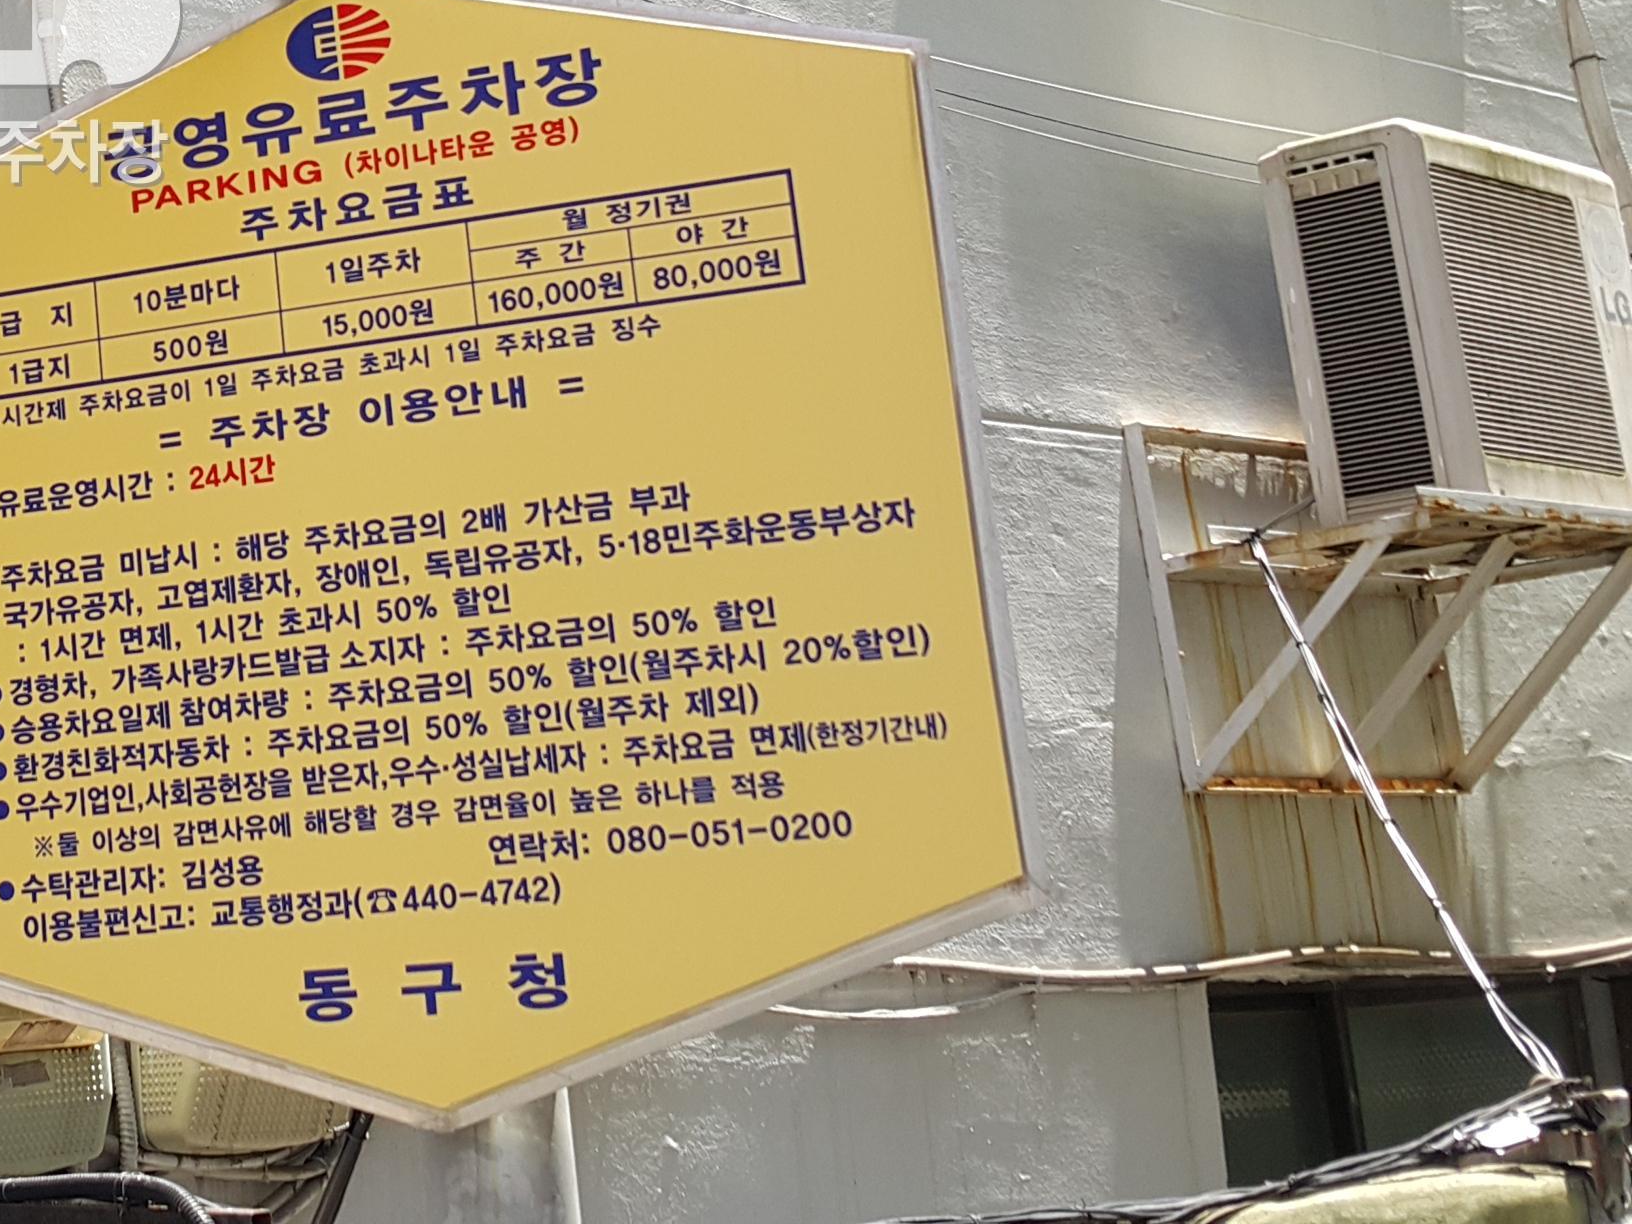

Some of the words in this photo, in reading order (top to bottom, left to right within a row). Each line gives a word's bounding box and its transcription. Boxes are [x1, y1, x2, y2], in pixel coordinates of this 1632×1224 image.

[130, 159, 322, 214] PARKING
[343, 129, 495, 179] (차이나타운
[510, 114, 579, 152] 공영)
[239, 174, 474, 241] 주차요금표
[605, 191, 692, 225] 정기권
[324, 246, 421, 284] 1일주차
[652, 247, 782, 291] 80,000원
[132, 274, 240, 314] 10분마다
[487, 270, 625, 313] 160,000원
[1599, 286, 1631, 326] LG
[321, 297, 434, 337] 15,000원
[8, 352, 70, 385] 1급지
[78, 378, 191, 417] 주차요금이
[203, 371, 237, 397] 1일
[250, 356, 344, 392] 주차요금
[358, 343, 430, 376] 초과시
[444, 336, 480, 363] 1일
[494, 321, 595, 357] 주차요금
[611, 313, 661, 342] 징수
[152, 328, 229, 363] 500원
[209, 401, 330, 449] 주차장
[358, 374, 527, 426] 이용안내
[188, 452, 276, 490] 24시간
[0, 552, 105, 592] 주차요금
[118, 540, 198, 577] 미납시
[234, 528, 290, 562] 해당
[303, 509, 447, 555] 주차요금의
[460, 501, 507, 534] 2배
[523, 490, 613, 528] 가산금
[628, 480, 690, 517] 부과
[2, 586, 143, 629] 국가유공자,
[156, 567, 301, 610] 고엽제환자,
[315, 554, 410, 593] 장애인,
[424, 535, 582, 579] 독립유공자,
[39, 628, 106, 662] 1시간
[118, 620, 181, 655] 면제,
[195, 610, 264, 644] 1시간
[277, 598, 361, 636] 초과시
[375, 592, 438, 624] 50%
[451, 582, 511, 618] 할인
[8, 669, 96, 707] 경형차,
[110, 643, 330, 694] 가족사랑카드발급
[338, 632, 426, 669] 소지자
[464, 611, 616, 657] 주차요금의
[631, 606, 698, 638] 50%
[713, 595, 777, 633] 할인
[10, 699, 171, 745] 승용차요일제
[179, 686, 289, 727] 참여차량
[327, 667, 473, 712] 주차요금의
[488, 662, 552, 694] 50%
[782, 622, 930, 665] 20%할인)
[12, 732, 230, 783] 환경친화적자동차
[266, 714, 410, 758] 주차요금의
[424, 709, 488, 741] 50%
[684, 681, 759, 718] 제외)
[622, 727, 735, 767] 주차요금
[91, 822, 160, 854] 이상의
[172, 810, 292, 847] 감면사유에
[302, 803, 377, 835] 해당할
[390, 798, 441, 829] 경우
[453, 787, 556, 823] 감면율이
[568, 782, 622, 814] 높은
[634, 775, 715, 807] 하나를
[730, 769, 784, 800] 적용
[487, 827, 590, 866] 연락처:
[606, 809, 852, 854] 080-051-0200
[20, 862, 166, 904] 수탁관리자:
[181, 854, 264, 890] 김성용
[22, 902, 195, 943] 이용불편신고:
